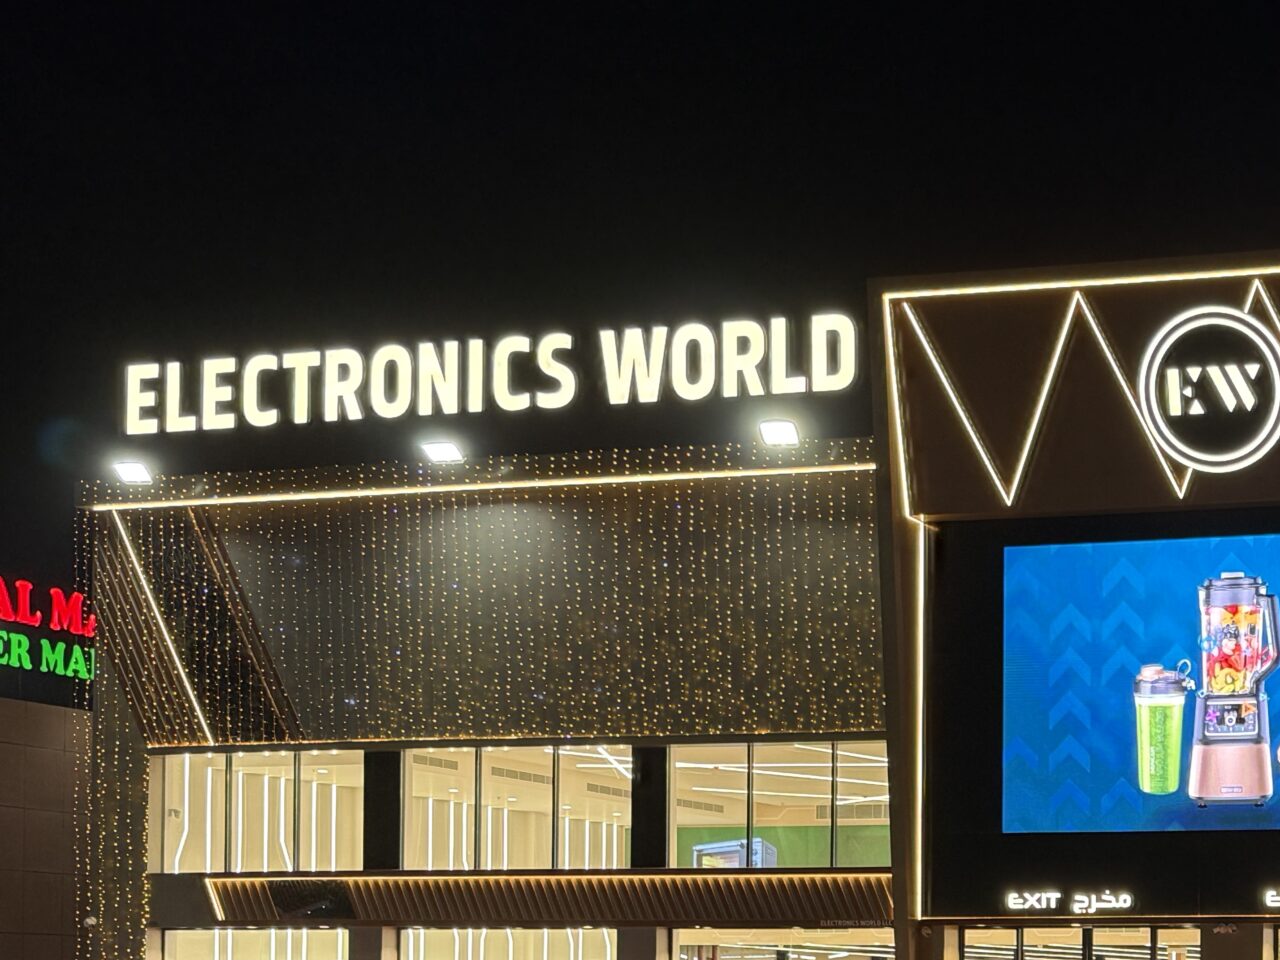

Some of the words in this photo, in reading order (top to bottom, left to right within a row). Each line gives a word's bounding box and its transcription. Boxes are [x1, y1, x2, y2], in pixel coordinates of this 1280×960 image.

[126, 332, 576, 436] ELECTRONICS
[600, 313, 858, 405] WORLD
[40, 638, 95, 680] MA
[1007, 891, 1062, 909] EXIT
[1072, 889, 1133, 914] مخرج
[820, 919, 860, 927] ELECTRONICS
